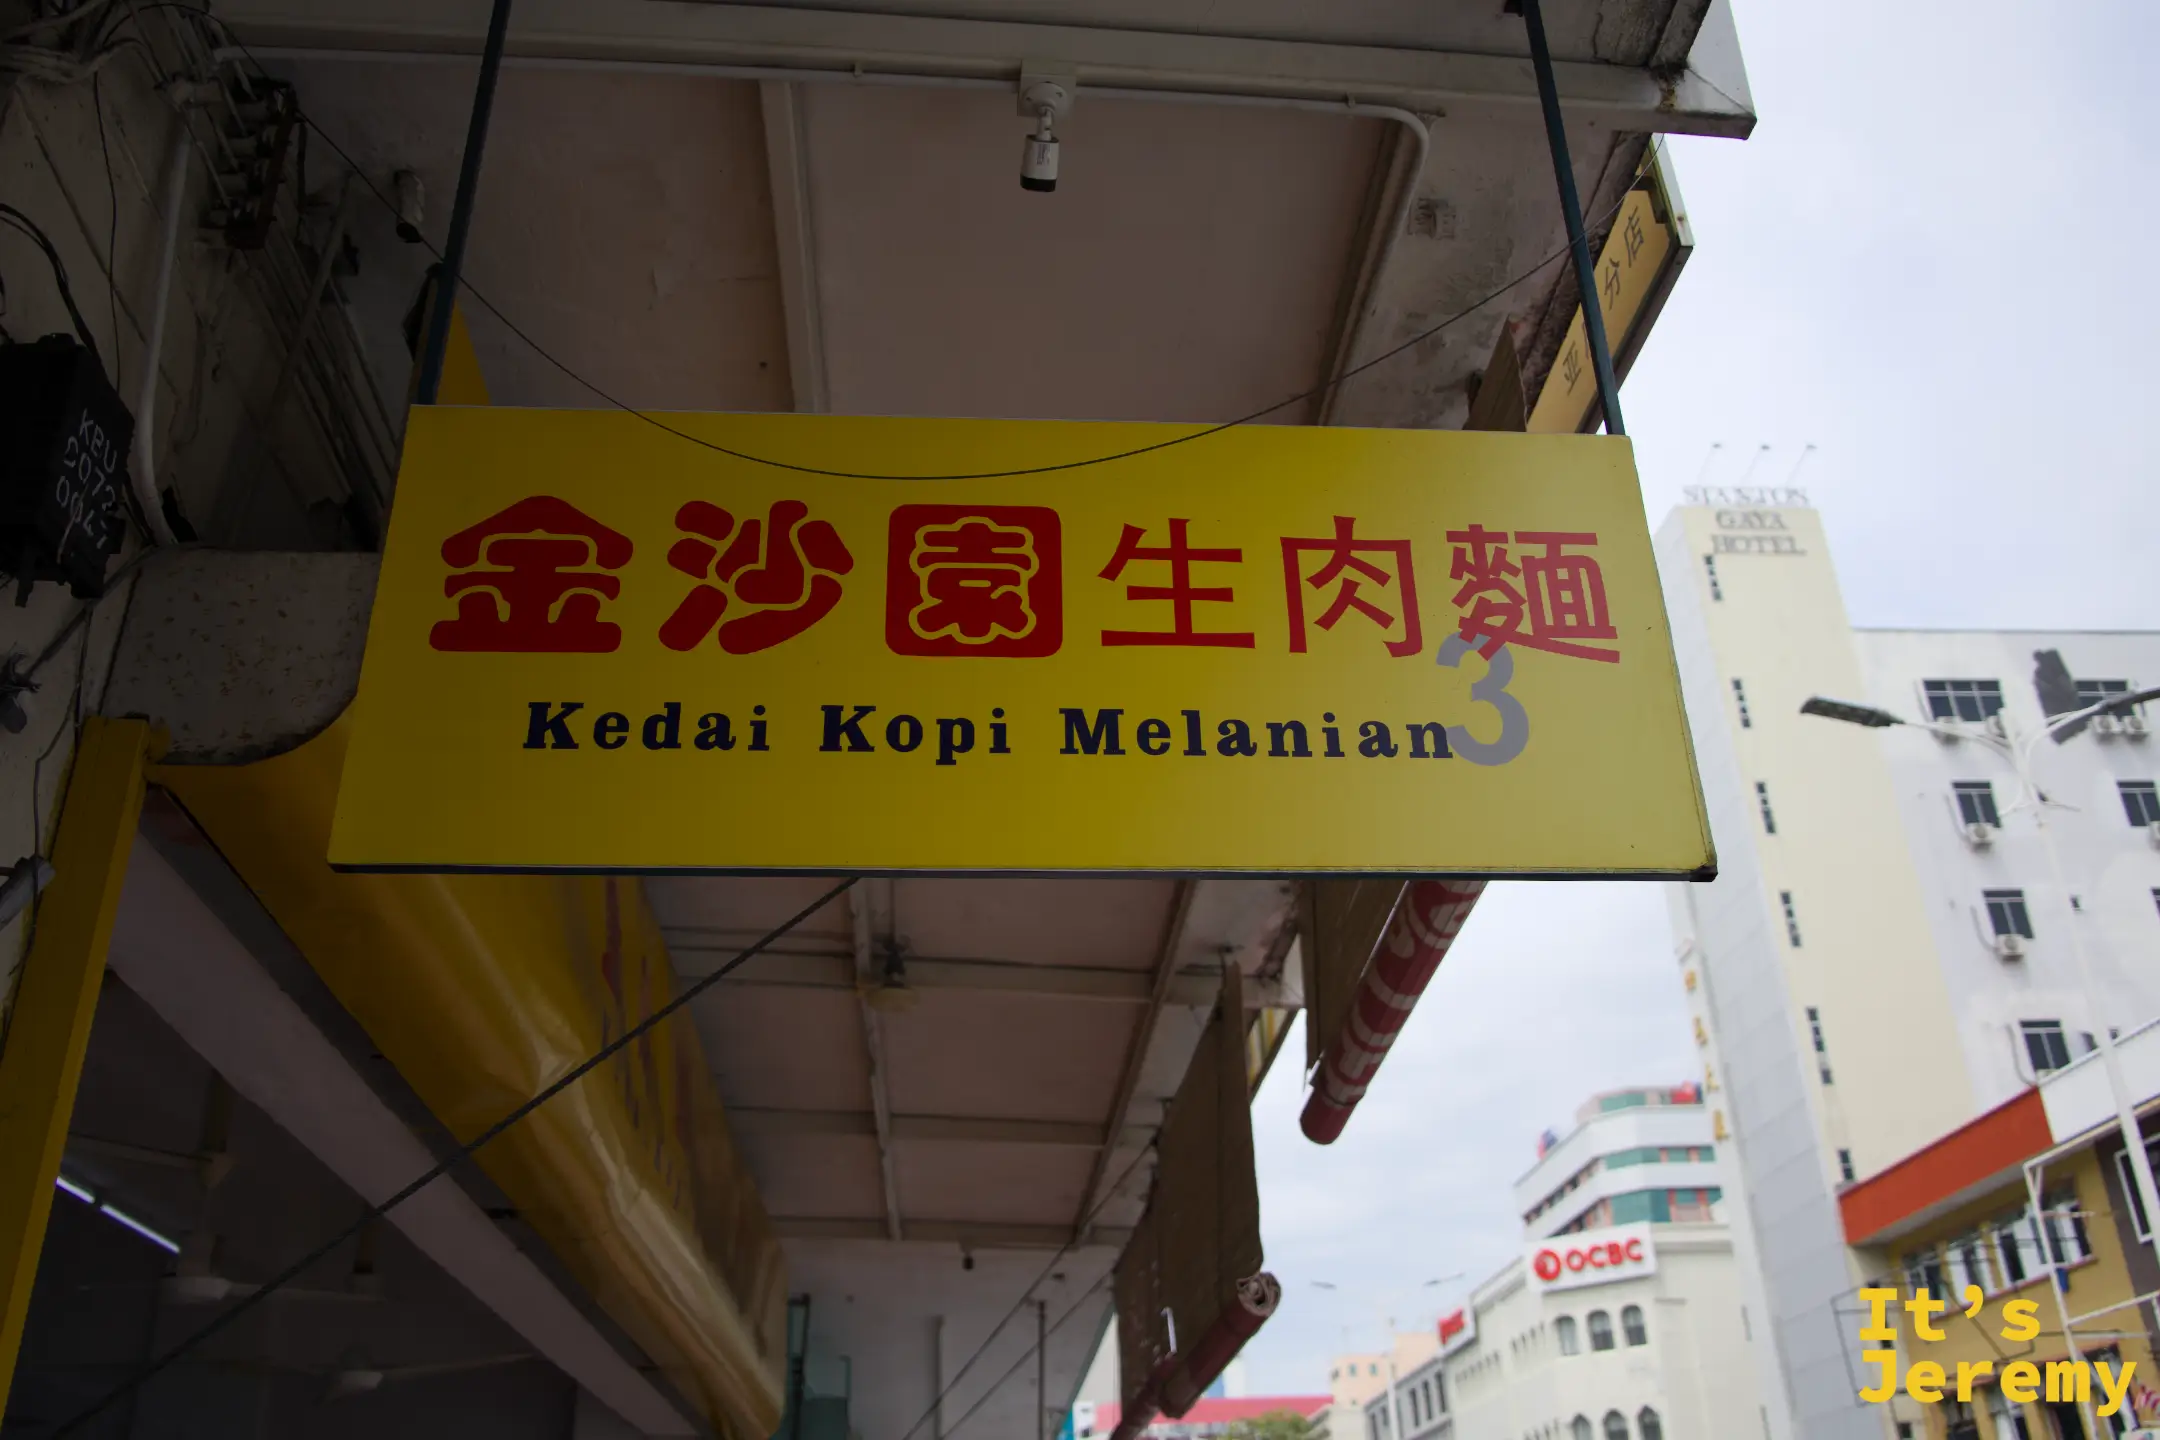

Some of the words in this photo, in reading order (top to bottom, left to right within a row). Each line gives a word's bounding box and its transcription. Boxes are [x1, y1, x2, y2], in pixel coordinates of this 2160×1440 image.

[1562, 206, 1645, 396] 亚分店
[1715, 508, 1789, 531] GAYA
[1711, 533, 1808, 557] HOTEL
[521, 700, 770, 752] Kedai
[818, 703, 1012, 766] Kopi
[1058, 707, 1454, 759] Melanian
[1436, 630, 1530, 767] 3
[1565, 1237, 1644, 1272] OCBC
